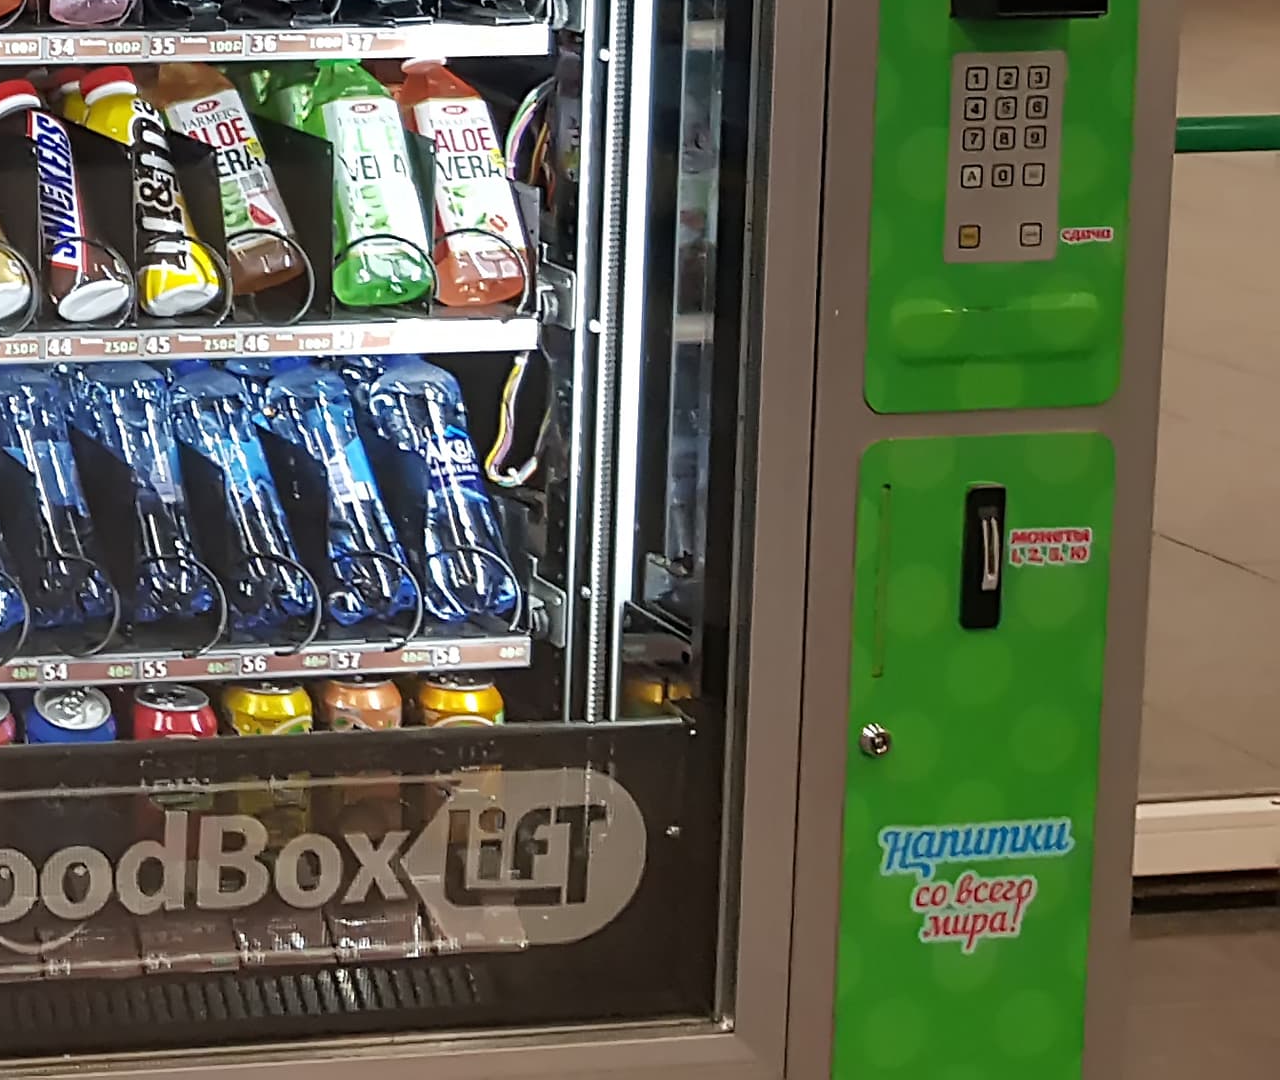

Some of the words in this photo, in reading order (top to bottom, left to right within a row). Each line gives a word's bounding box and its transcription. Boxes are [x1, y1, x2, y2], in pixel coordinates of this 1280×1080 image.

[49, 38, 74, 56] 34
[151, 37, 176, 55] 35
[434, 126, 494, 152] ALOE
[435, 153, 500, 181] VERA
[47, 338, 72, 355] 44
[146, 337, 170, 353] 45
[43, 663, 68, 681] 54
[143, 660, 167, 678] 55
[242, 655, 267, 673] 56
[883, 818, 1072, 877] Напитки
[915, 883, 947, 908] со
[954, 874, 1034, 919] всего
[923, 905, 1024, 951] мира!
